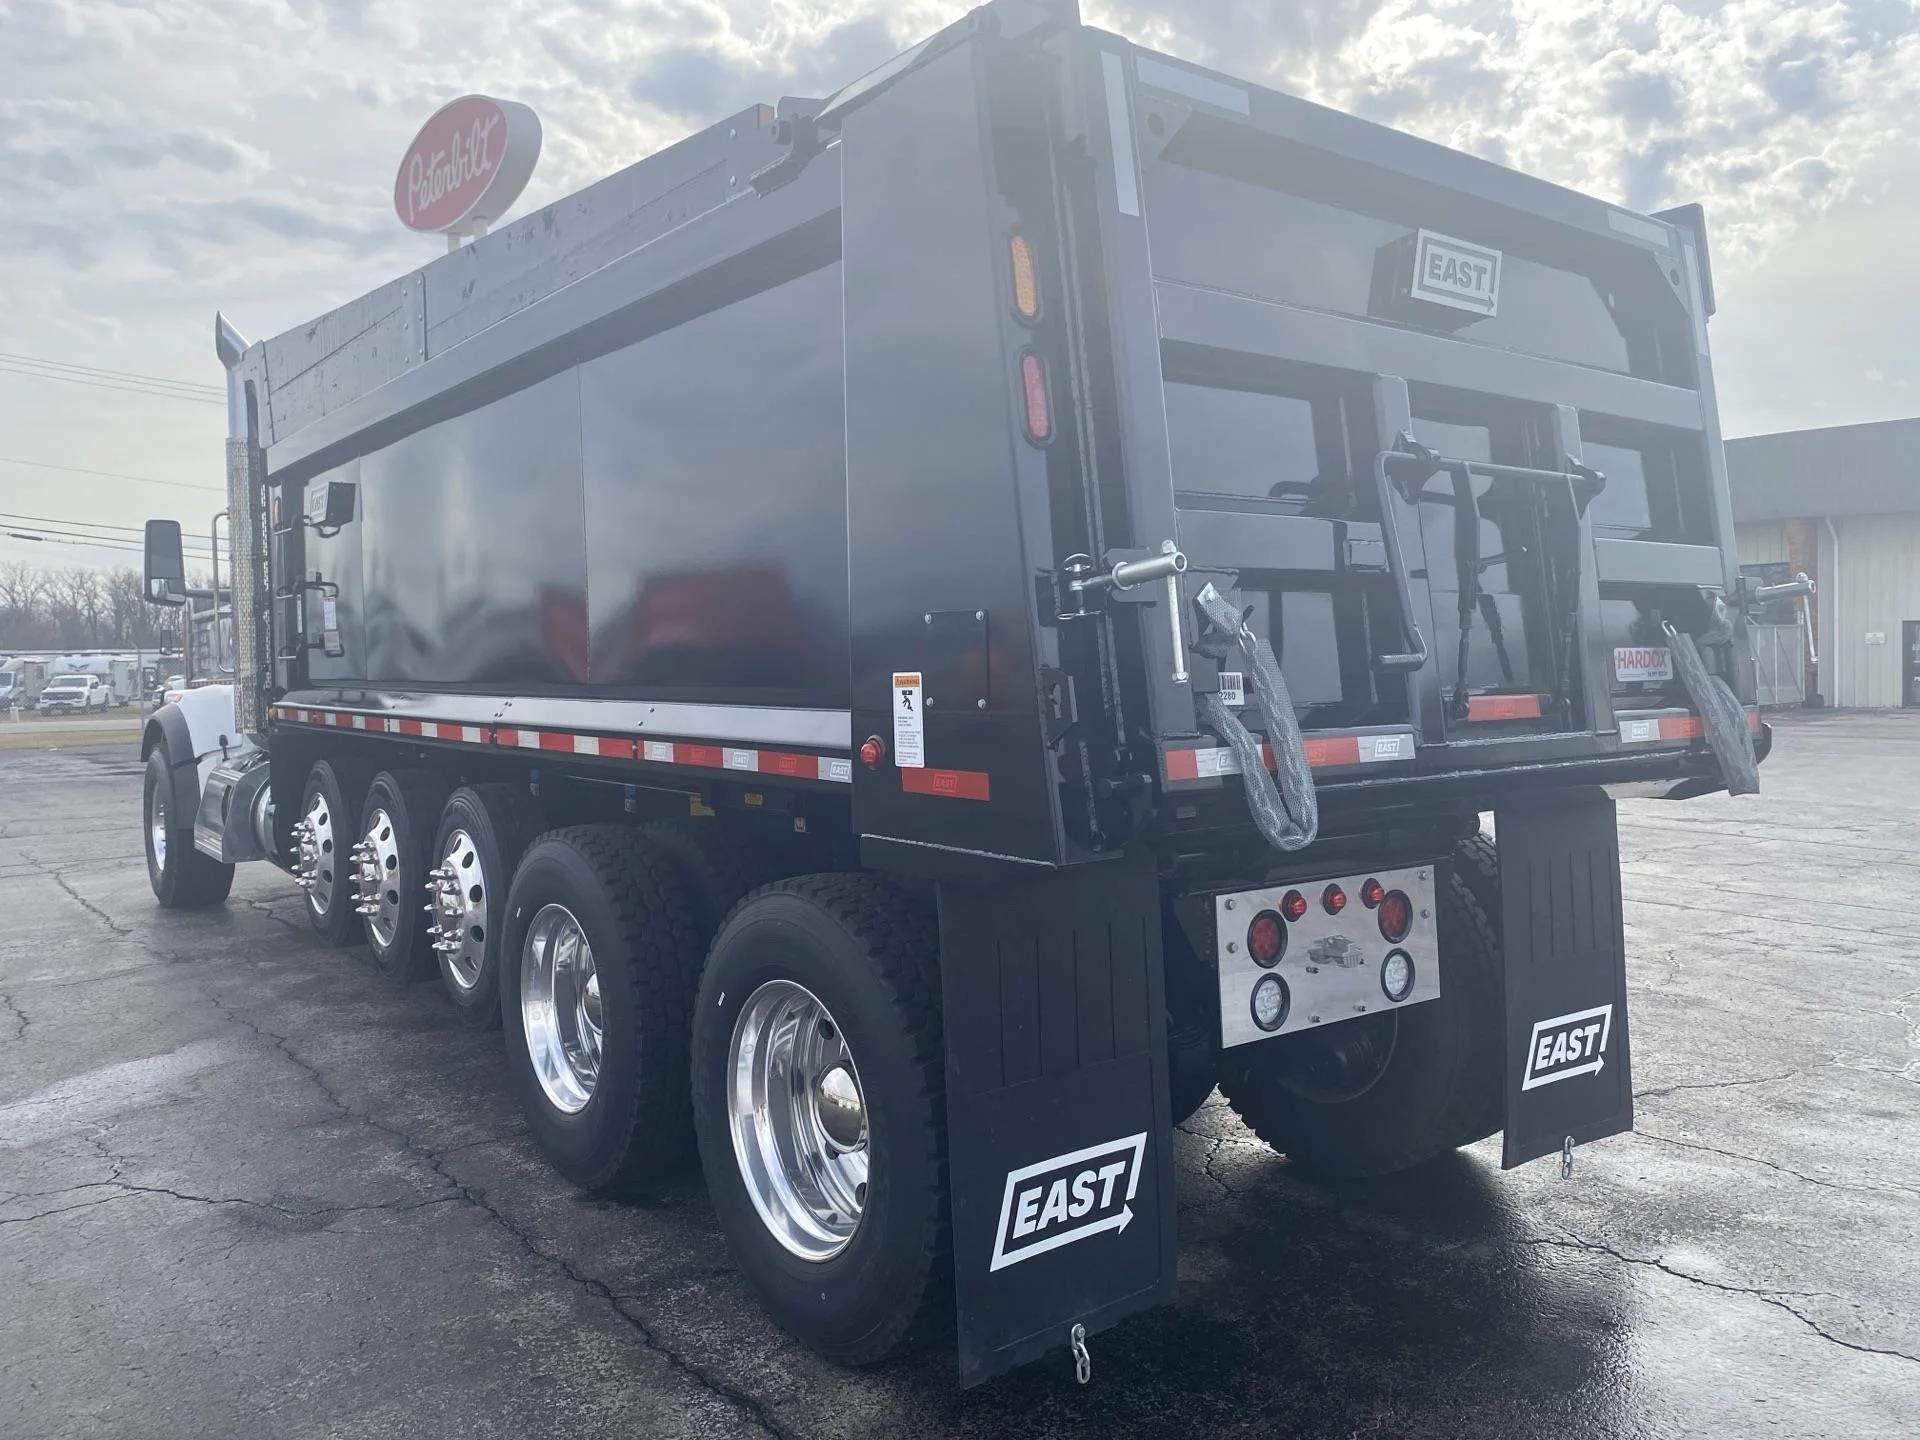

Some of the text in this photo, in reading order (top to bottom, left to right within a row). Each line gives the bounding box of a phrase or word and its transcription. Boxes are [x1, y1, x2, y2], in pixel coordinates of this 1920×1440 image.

[408, 113, 499, 222] Peterbilt
[1428, 252, 1487, 292] EAST
[1617, 650, 1668, 669] HARDOX
[1378, 743, 1397, 752] EAST
[832, 765, 848, 775] EAST
[1535, 1023, 1600, 1070] EAST
[1012, 1160, 1126, 1239] EAST
